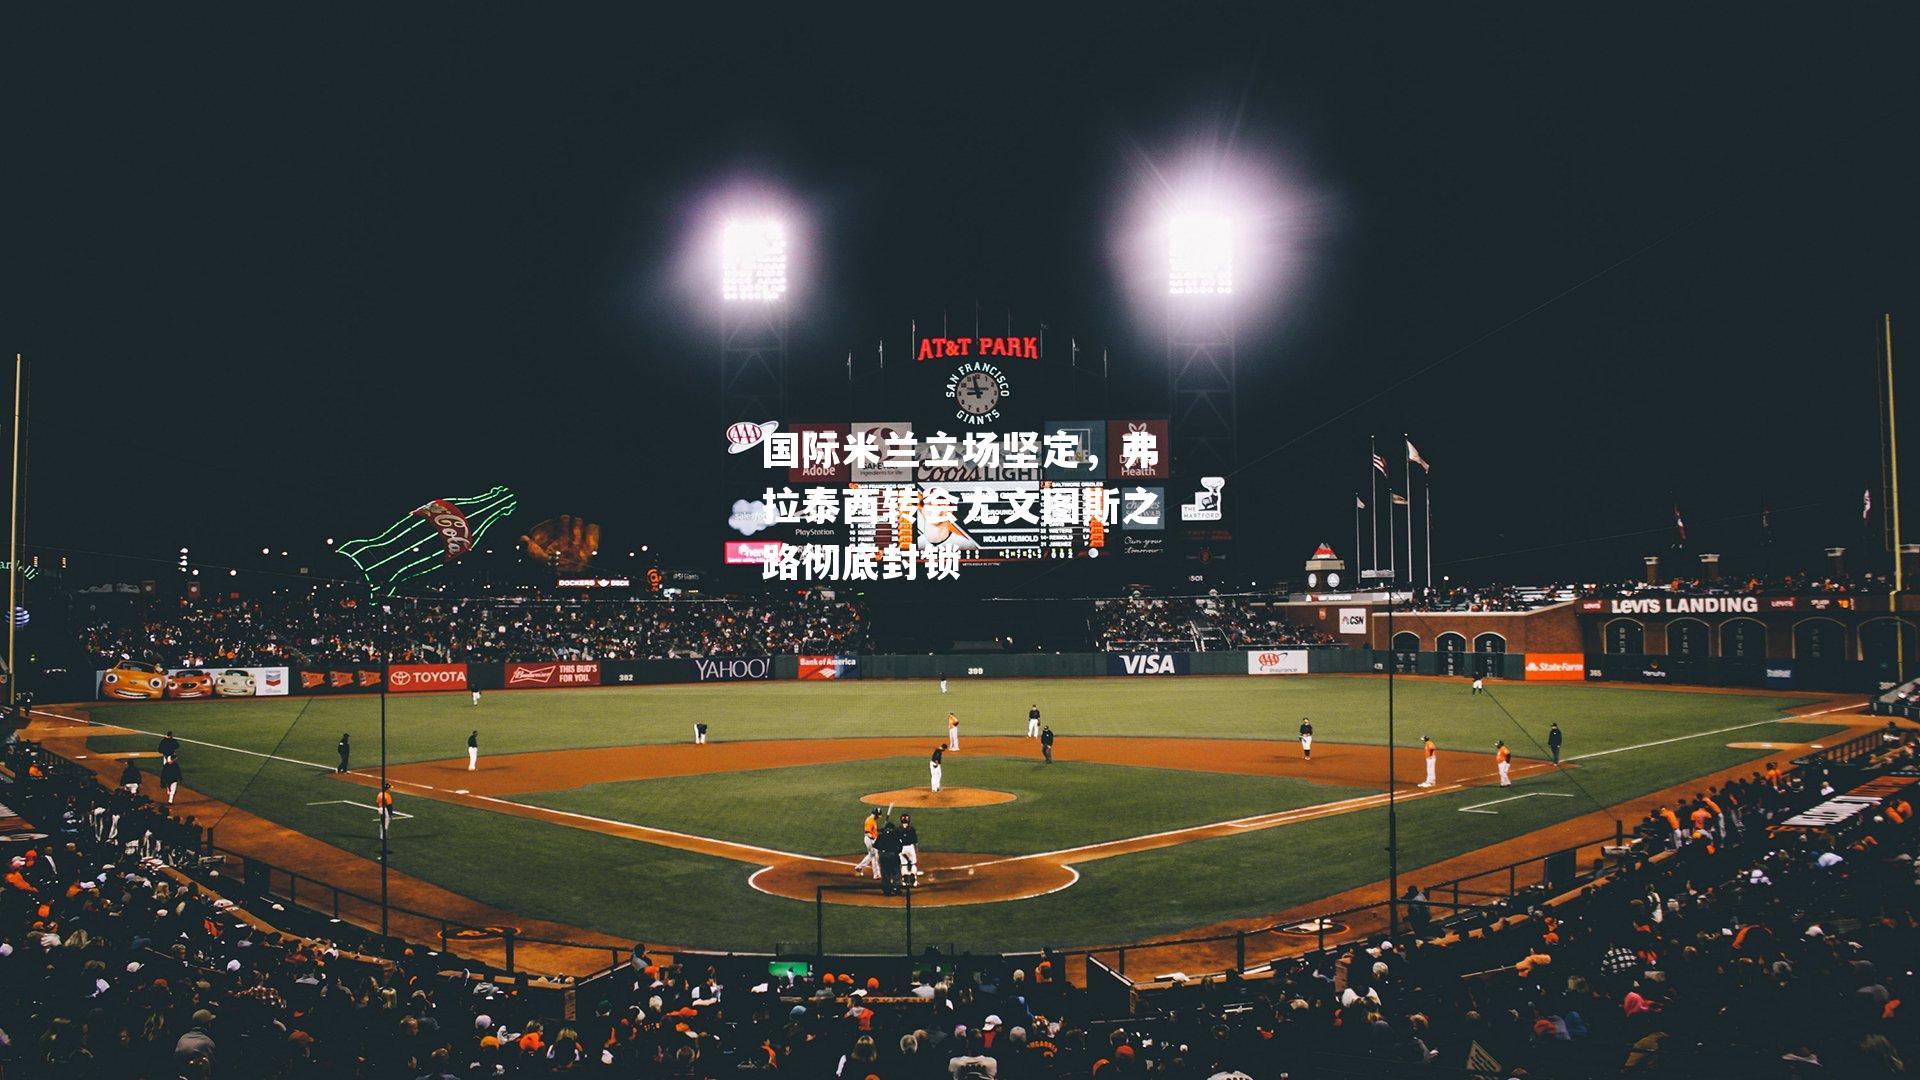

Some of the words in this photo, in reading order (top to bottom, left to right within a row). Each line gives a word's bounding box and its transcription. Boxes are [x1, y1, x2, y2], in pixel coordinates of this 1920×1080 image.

[917, 338, 972, 361] AT&T
[979, 337, 1039, 360] PARK
[945, 374, 959, 398] SAN
[957, 361, 1010, 397] FRANCISCO
[956, 409, 1001, 425] GIANTS
[916, 459, 981, 482] Coors
[795, 528, 835, 537] PlayStation
[983, 535, 1007, 543] NOLAN
[1008, 535, 1039, 543] REIMOLD
[1665, 597, 1758, 613] LANDING
[1349, 616, 1364, 625] CSN
[559, 665, 576, 673] THIS
[576, 664, 598, 673] BUD'S
[800, 658, 818, 666] Bank
[827, 658, 856, 666] America
[1118, 654, 1176, 675] VISA
[695, 658, 770, 681] YAHOO!
[413, 671, 467, 683] TOYOTA
[559, 674, 574, 682] FOR
[574, 674, 590, 682] YOU.
